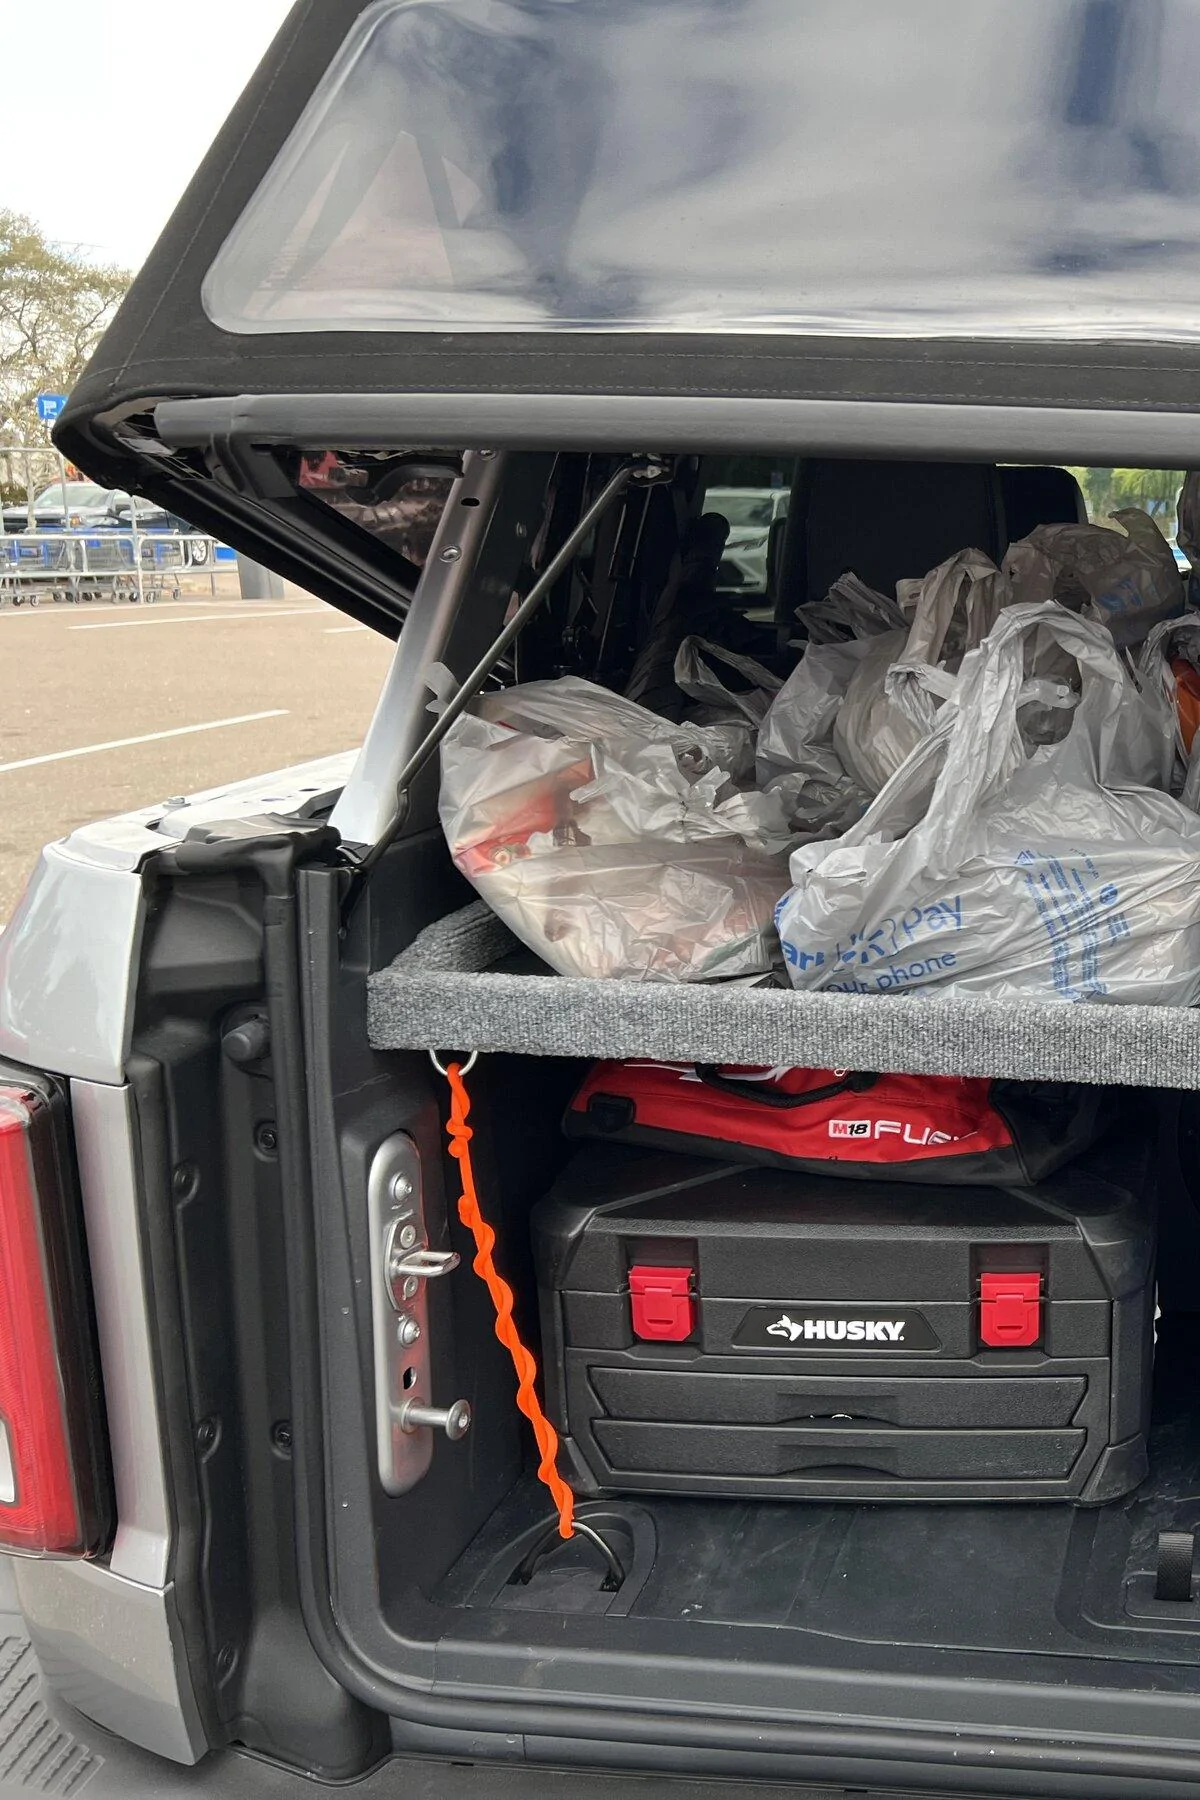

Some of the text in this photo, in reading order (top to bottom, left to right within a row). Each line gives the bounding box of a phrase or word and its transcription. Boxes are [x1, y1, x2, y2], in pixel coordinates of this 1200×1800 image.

[902, 895, 963, 942] Pay
[875, 952, 957, 991] phone
[831, 1119, 960, 1146] M18 FUE
